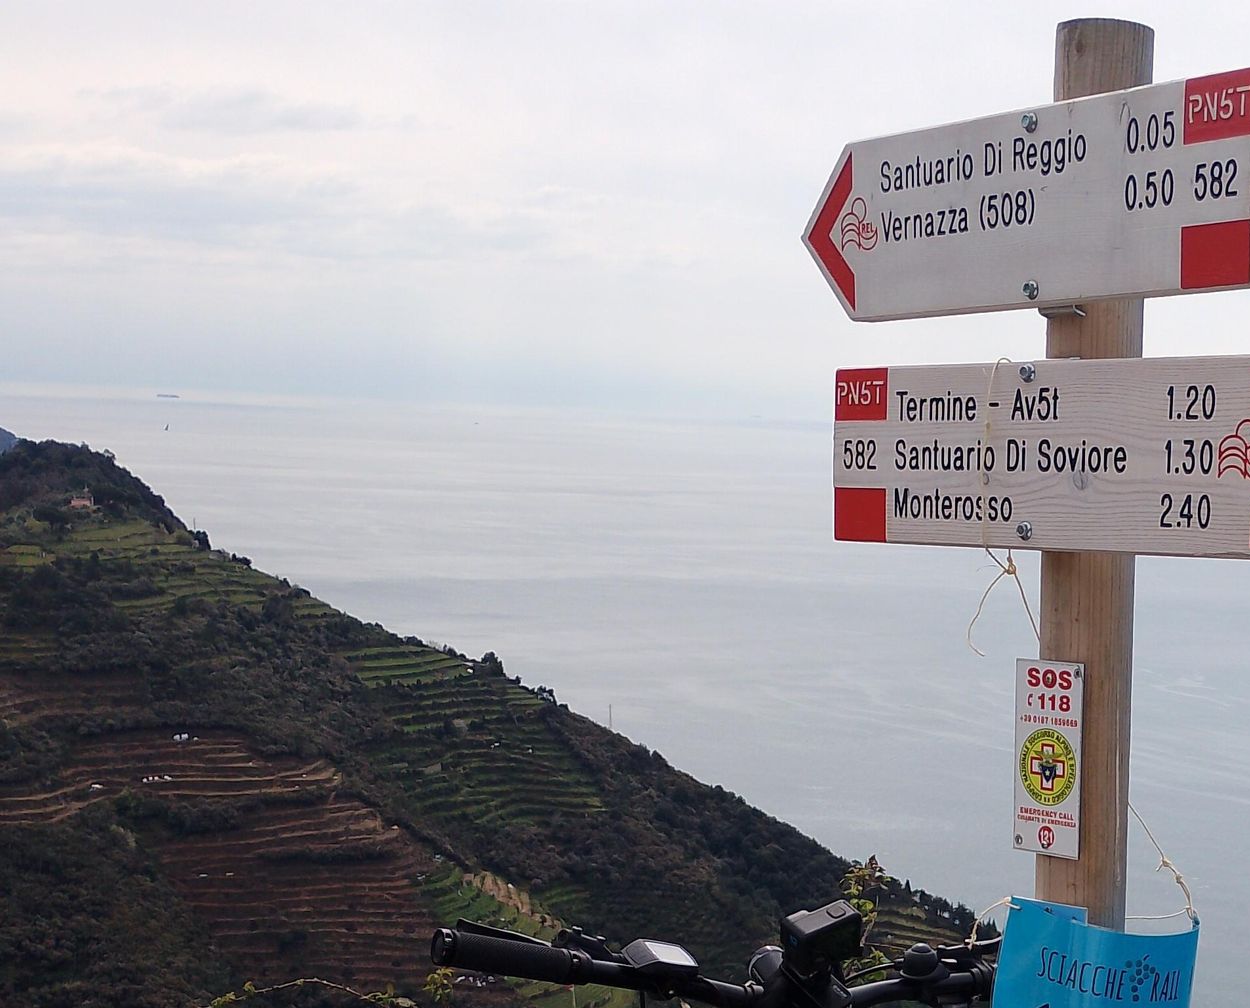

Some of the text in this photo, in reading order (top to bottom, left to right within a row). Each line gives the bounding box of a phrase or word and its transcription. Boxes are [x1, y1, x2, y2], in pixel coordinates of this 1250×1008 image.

[880, 110, 1175, 193] Santuario Di Reggio 0.05
[881, 158, 1238, 243] Vernazza (508) 0.50 582
[861, 222, 874, 234] REL
[895, 391, 977, 422] Termine
[1010, 386, 1059, 422] Av5t
[1166, 383, 1216, 422] 1.20
[843, 439, 877, 470] 582
[894, 438, 1214, 475] Santuario Di Soviore 1.30
[894, 487, 1212, 530] Monterosso 2.40
[1027, 667, 1073, 690] SOS
[1038, 693, 1071, 712] 118
[1020, 806, 1074, 821] EMERGENCY CALL
[1036, 946, 1180, 1002] SCIACCHE RAIL
